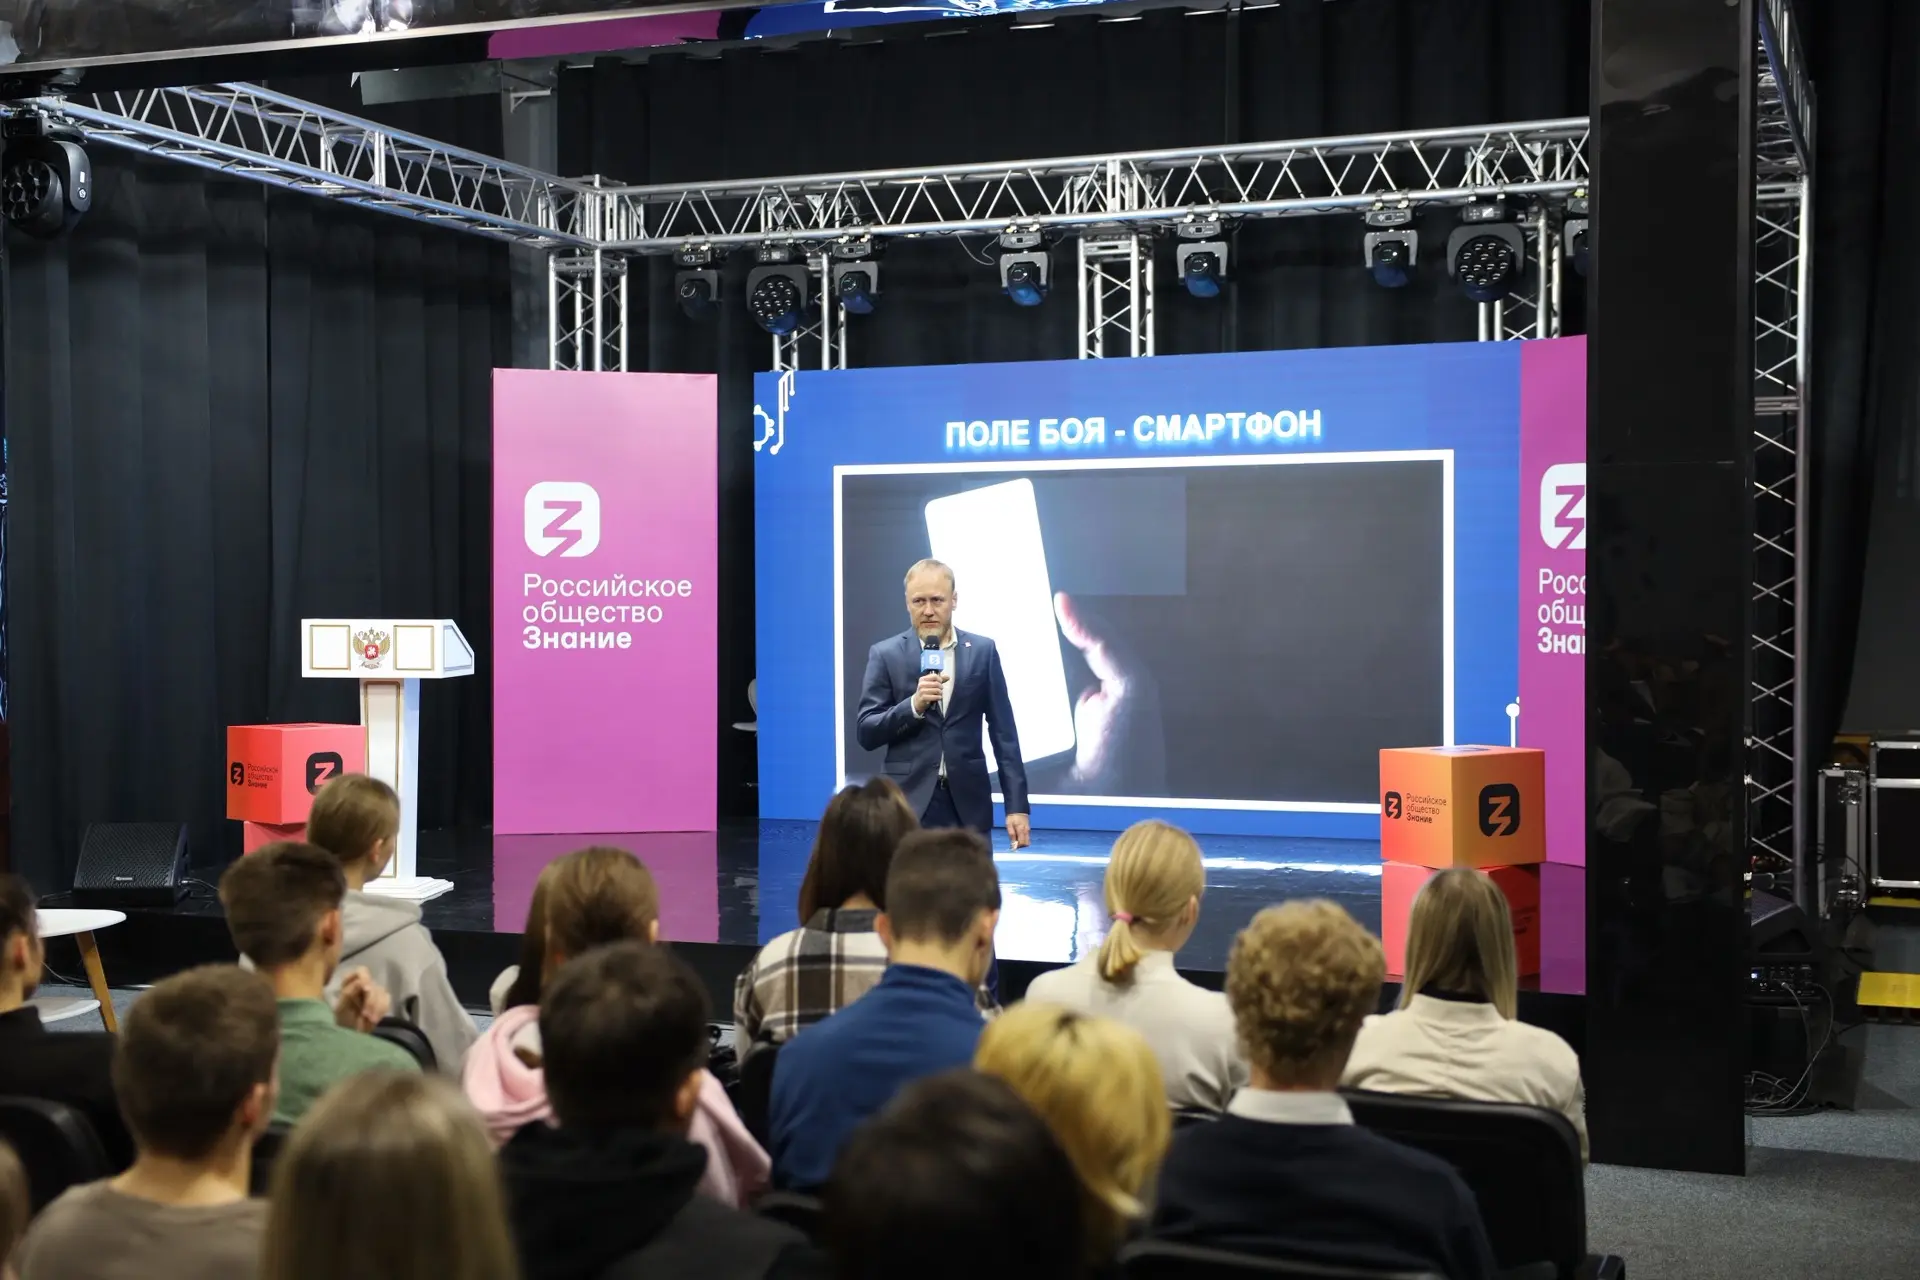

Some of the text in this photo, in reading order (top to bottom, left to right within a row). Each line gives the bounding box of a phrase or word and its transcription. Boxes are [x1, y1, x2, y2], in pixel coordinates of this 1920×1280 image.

[945, 419, 1031, 448] ПОЛЕ
[1038, 416, 1106, 446] БОЯ
[1133, 409, 1322, 443] СМАРТФОН
[523, 572, 693, 598] Российское
[522, 599, 663, 627] общество
[522, 625, 633, 650] Знание
[1537, 626, 1586, 655] Зна
[1405, 792, 1447, 807] Российское
[1405, 803, 1441, 815] общество
[1405, 812, 1433, 824] Знание
